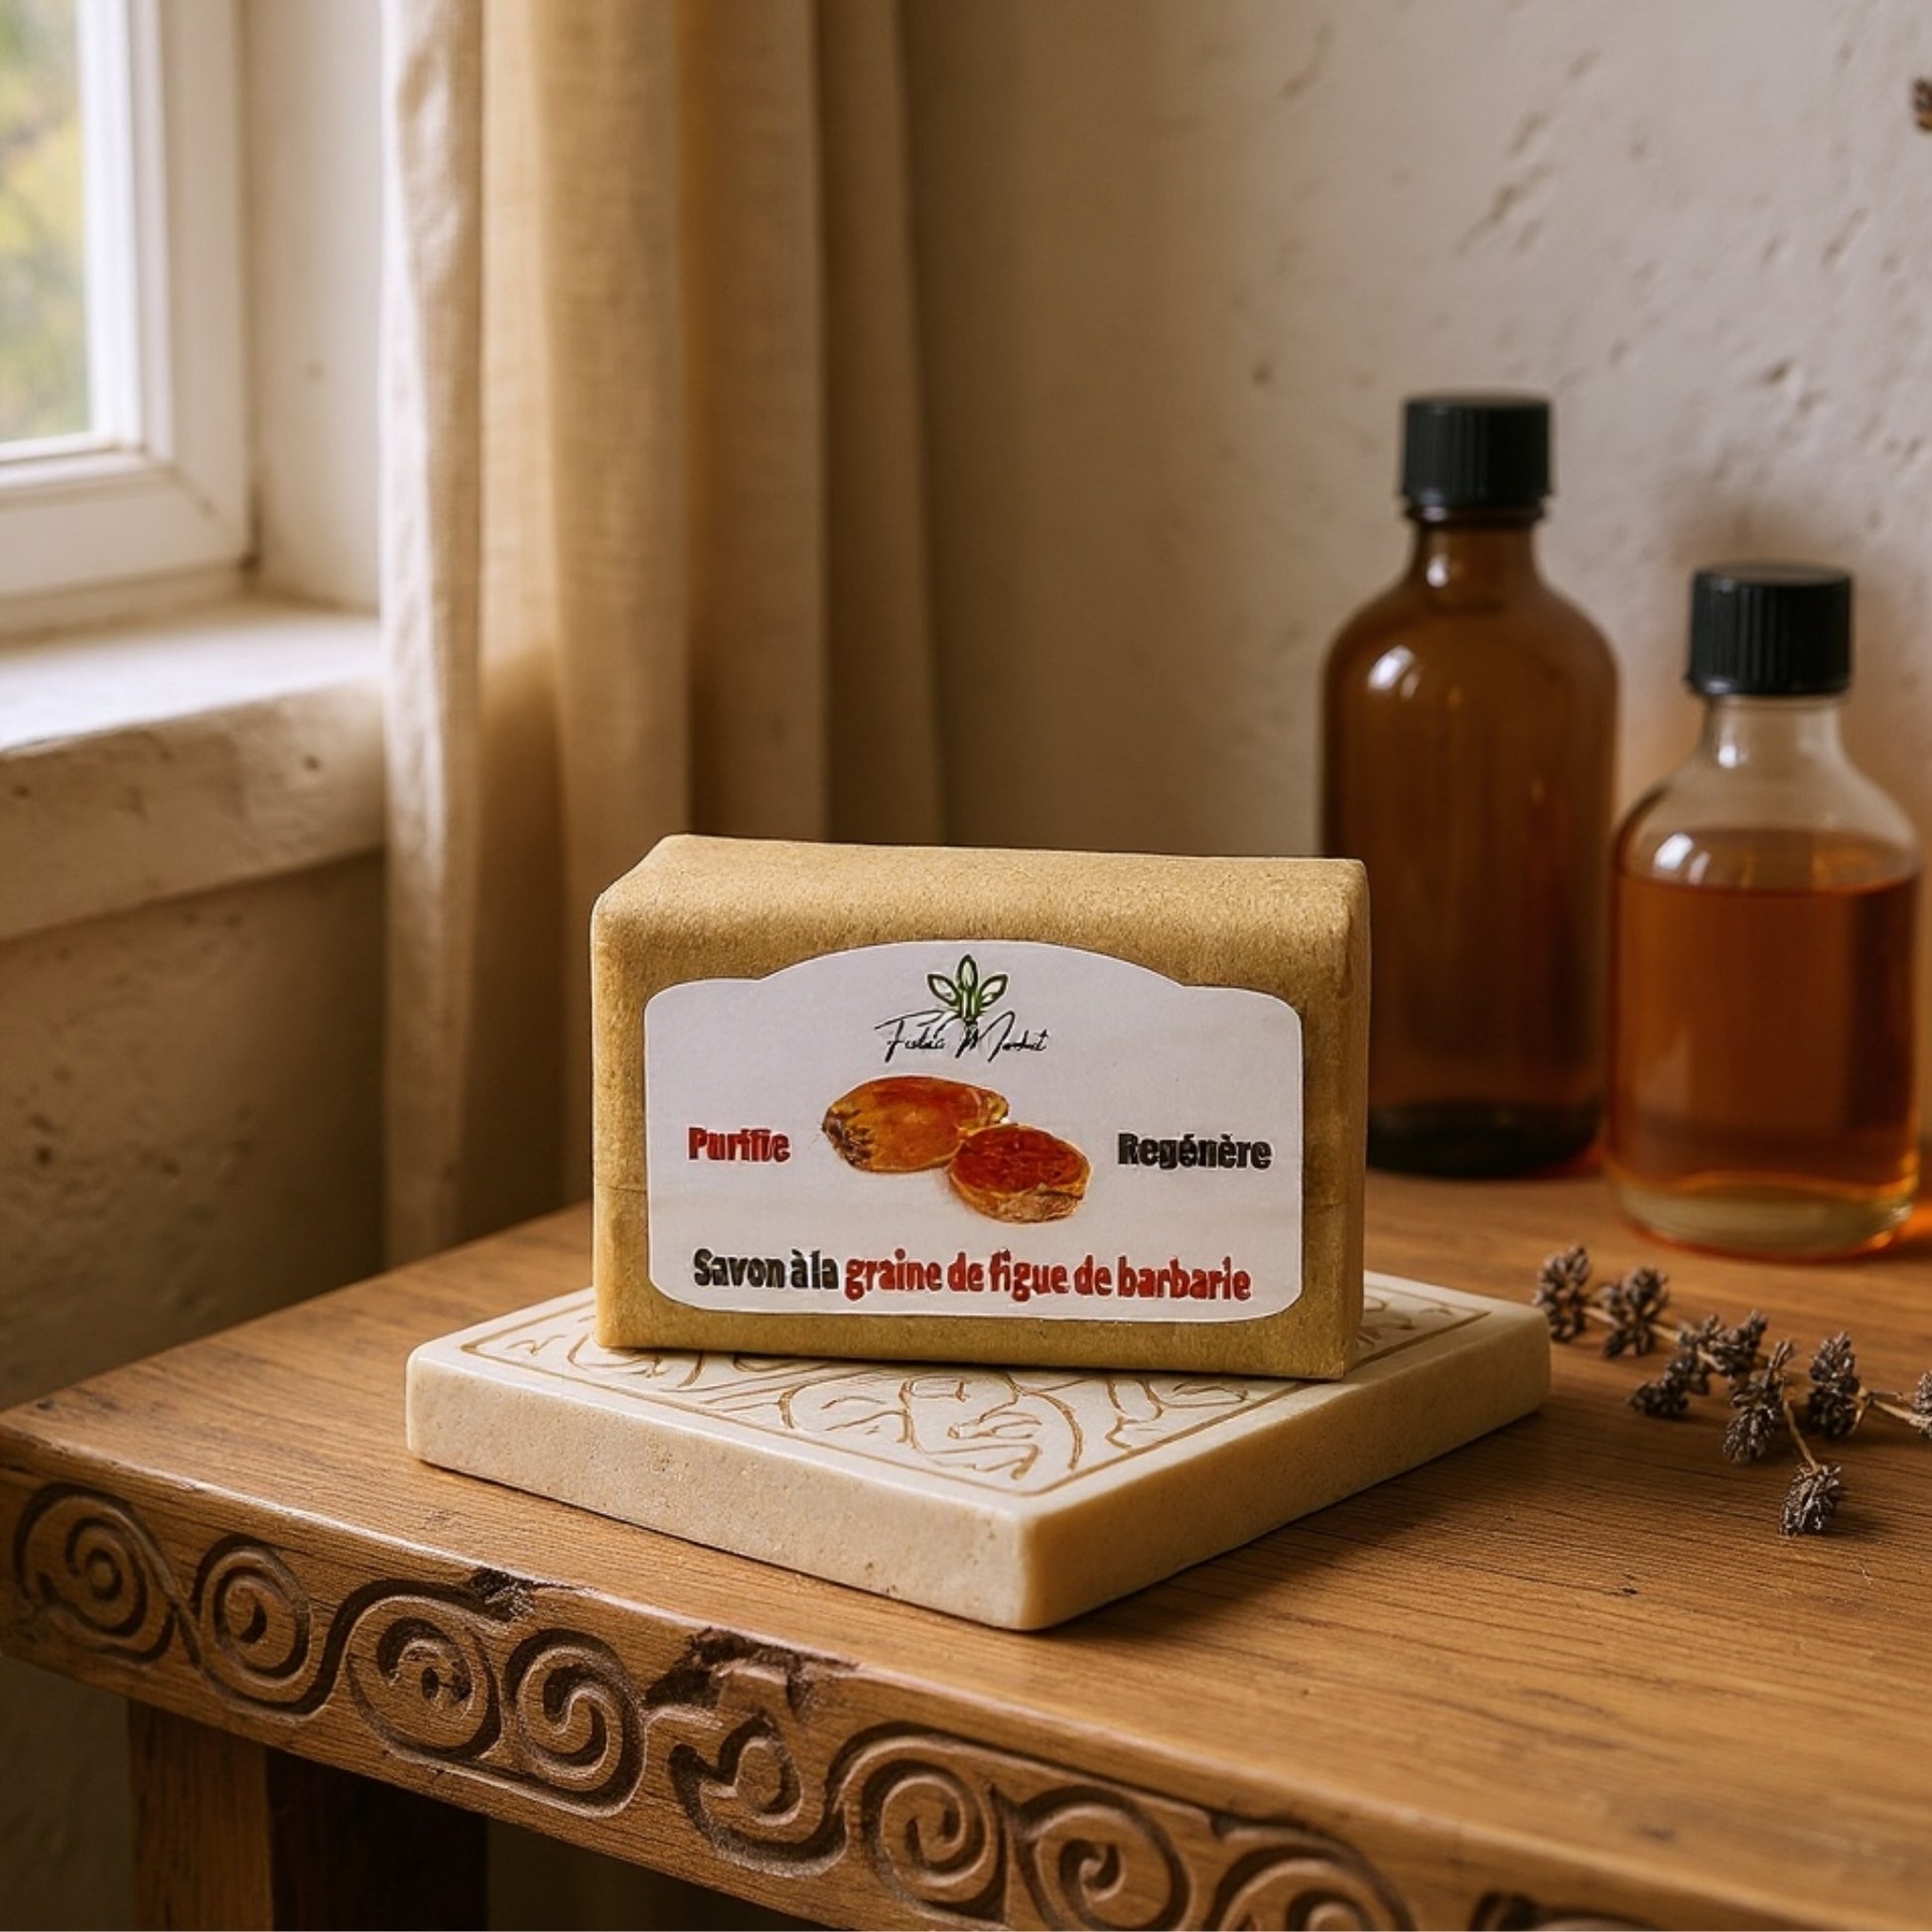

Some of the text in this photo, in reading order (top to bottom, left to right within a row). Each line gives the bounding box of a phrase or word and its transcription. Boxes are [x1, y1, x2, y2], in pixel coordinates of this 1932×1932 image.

[1118, 1133, 1272, 1169] Regénère
[694, 1247, 1251, 1303] Savon à la graine de figue de barbarie
